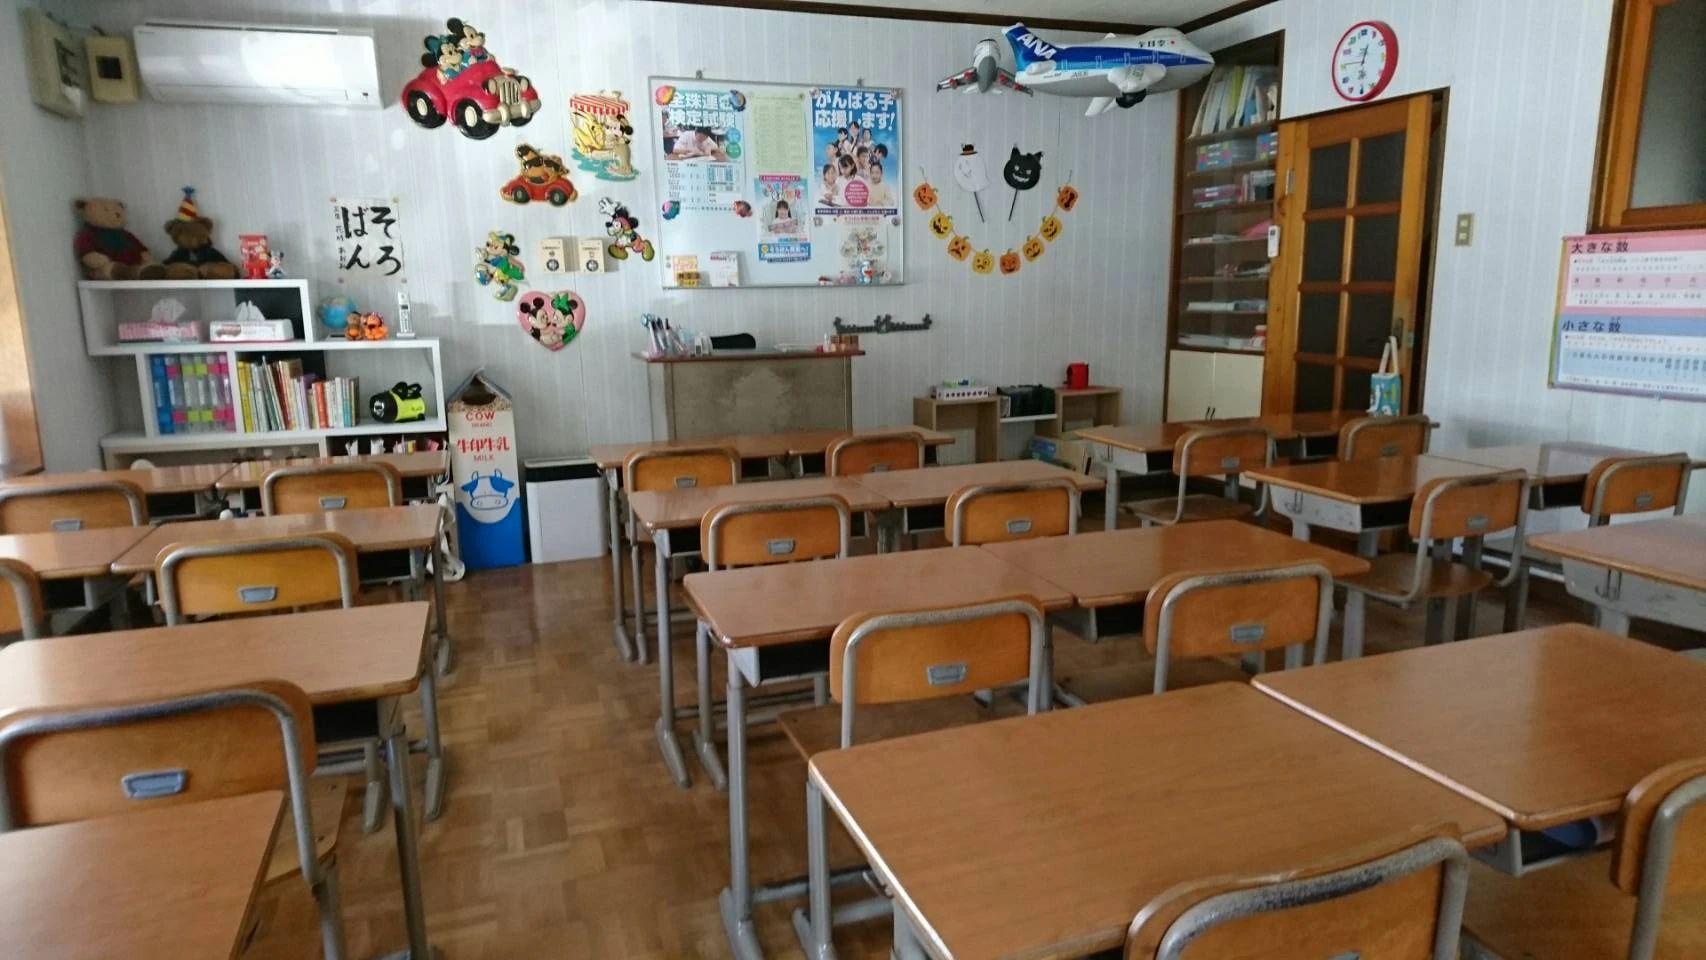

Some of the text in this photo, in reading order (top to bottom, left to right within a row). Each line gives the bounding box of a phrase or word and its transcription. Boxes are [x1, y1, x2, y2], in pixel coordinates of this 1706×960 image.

[1016, 33, 1057, 60] ANA
[815, 89, 894, 111] がんばる子
[667, 109, 735, 128] 検定試験
[814, 109, 896, 131] 応援します!
[1571, 241, 1629, 254] 大きな数
[1562, 320, 1622, 333] 小さな数
[465, 411, 496, 421] COW
